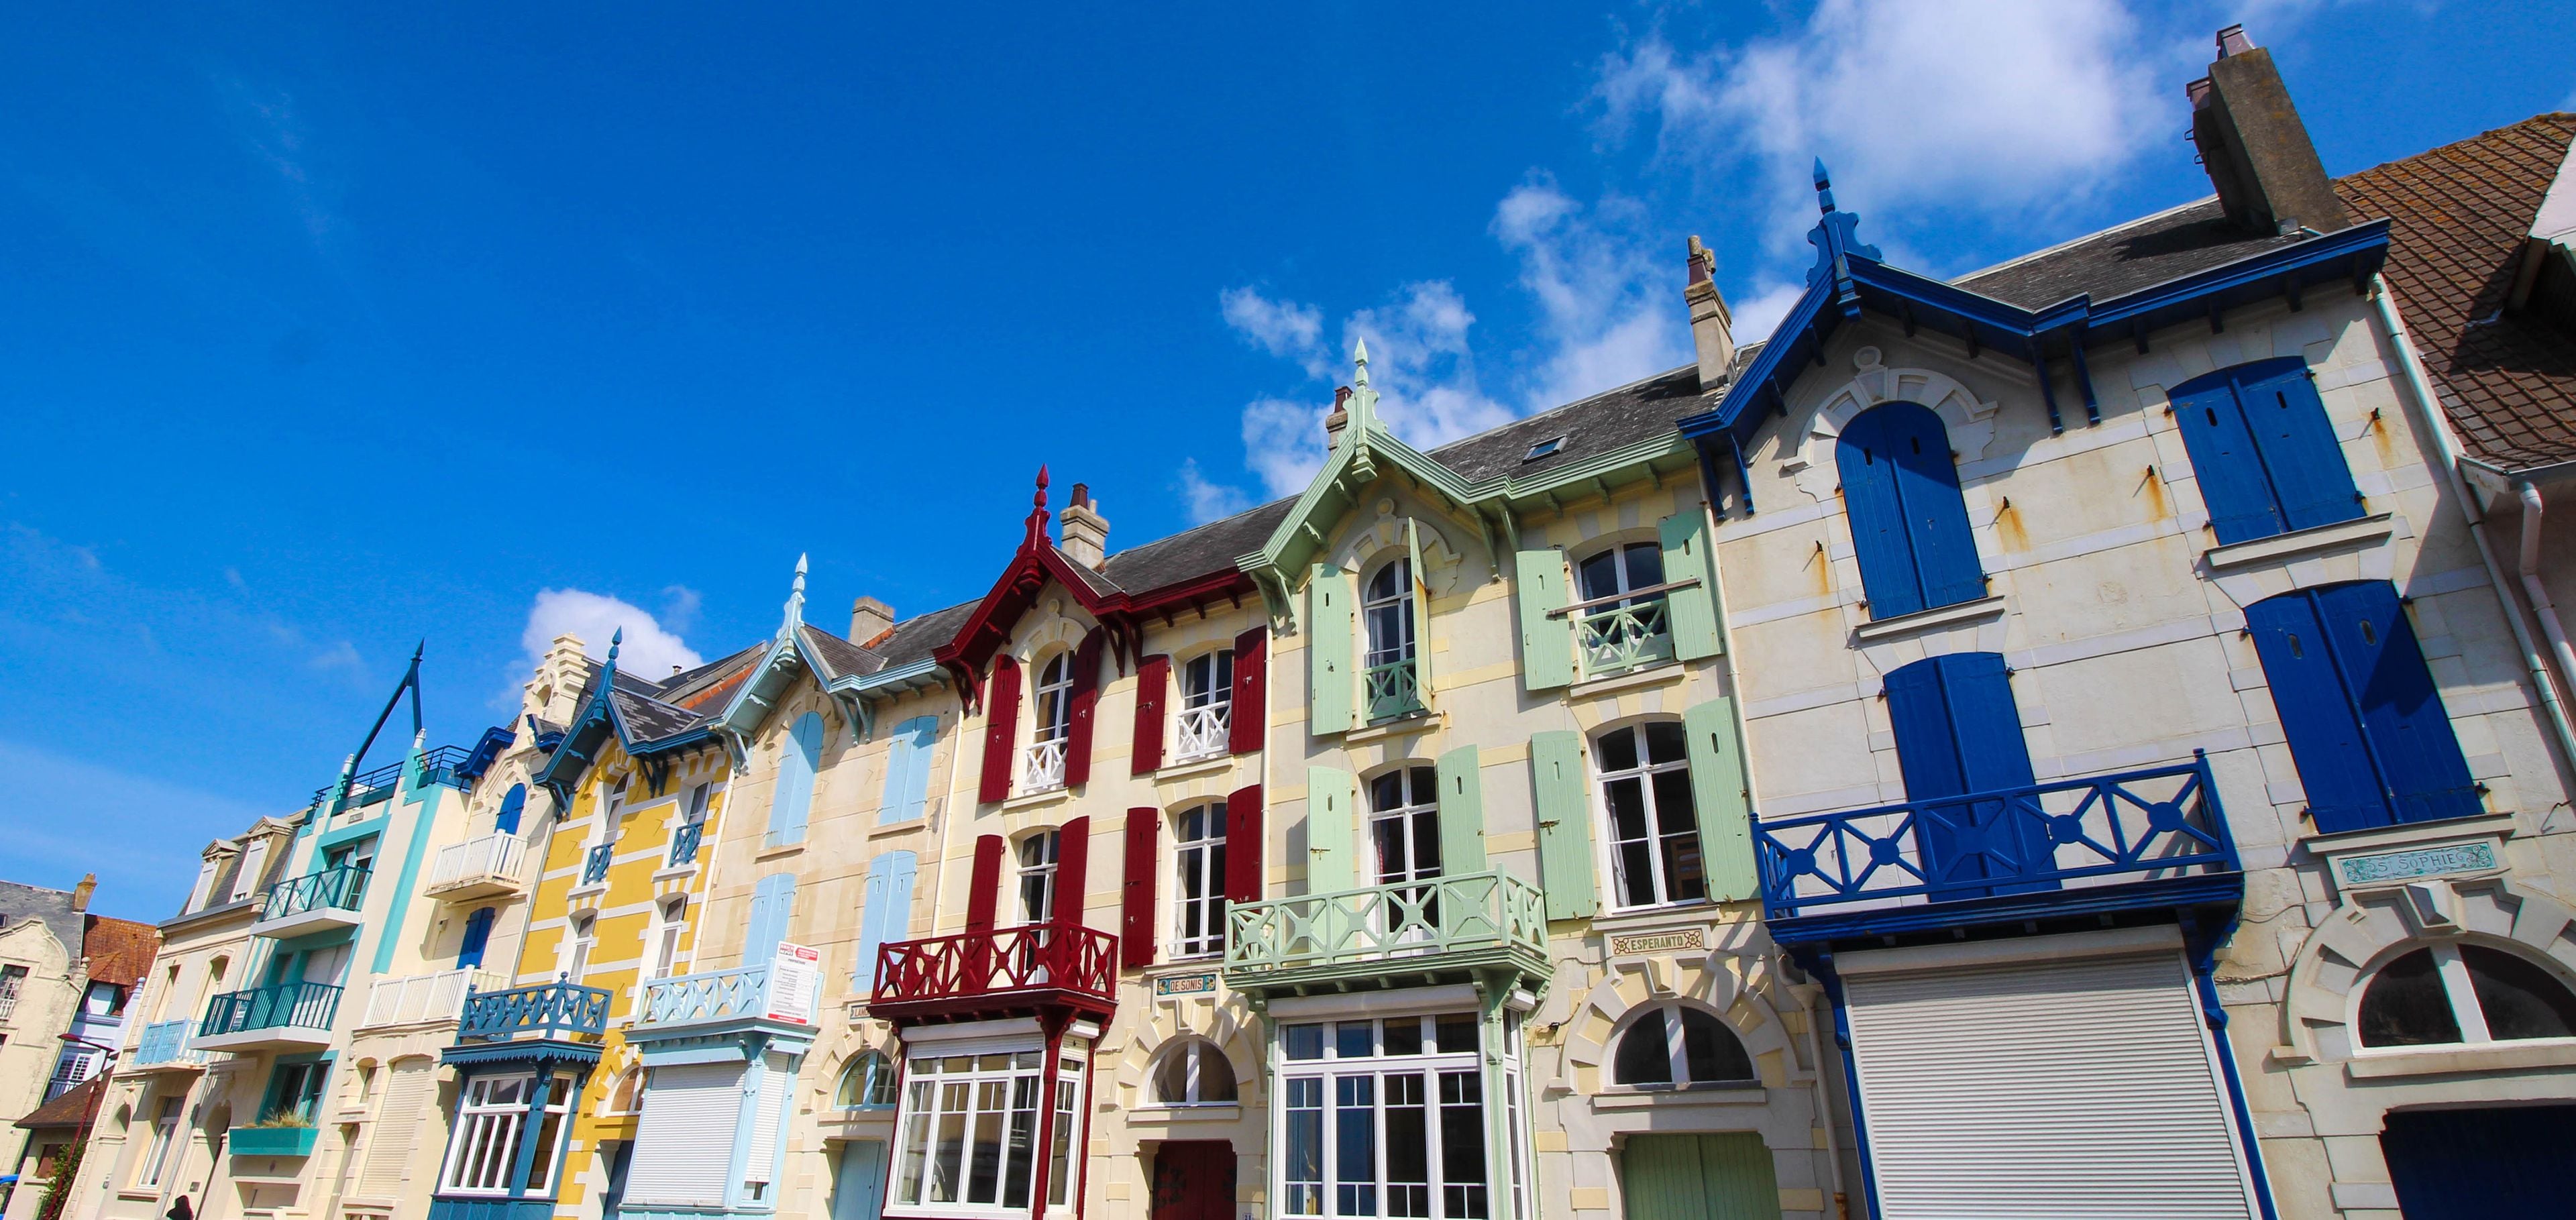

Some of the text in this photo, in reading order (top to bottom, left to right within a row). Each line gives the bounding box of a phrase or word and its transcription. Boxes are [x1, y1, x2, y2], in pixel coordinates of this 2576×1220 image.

[2399, 854, 2455, 869] SOPHIE
[1631, 936, 1683, 950] ESPERANTO
[1170, 979, 1201, 991] DE SONIS
